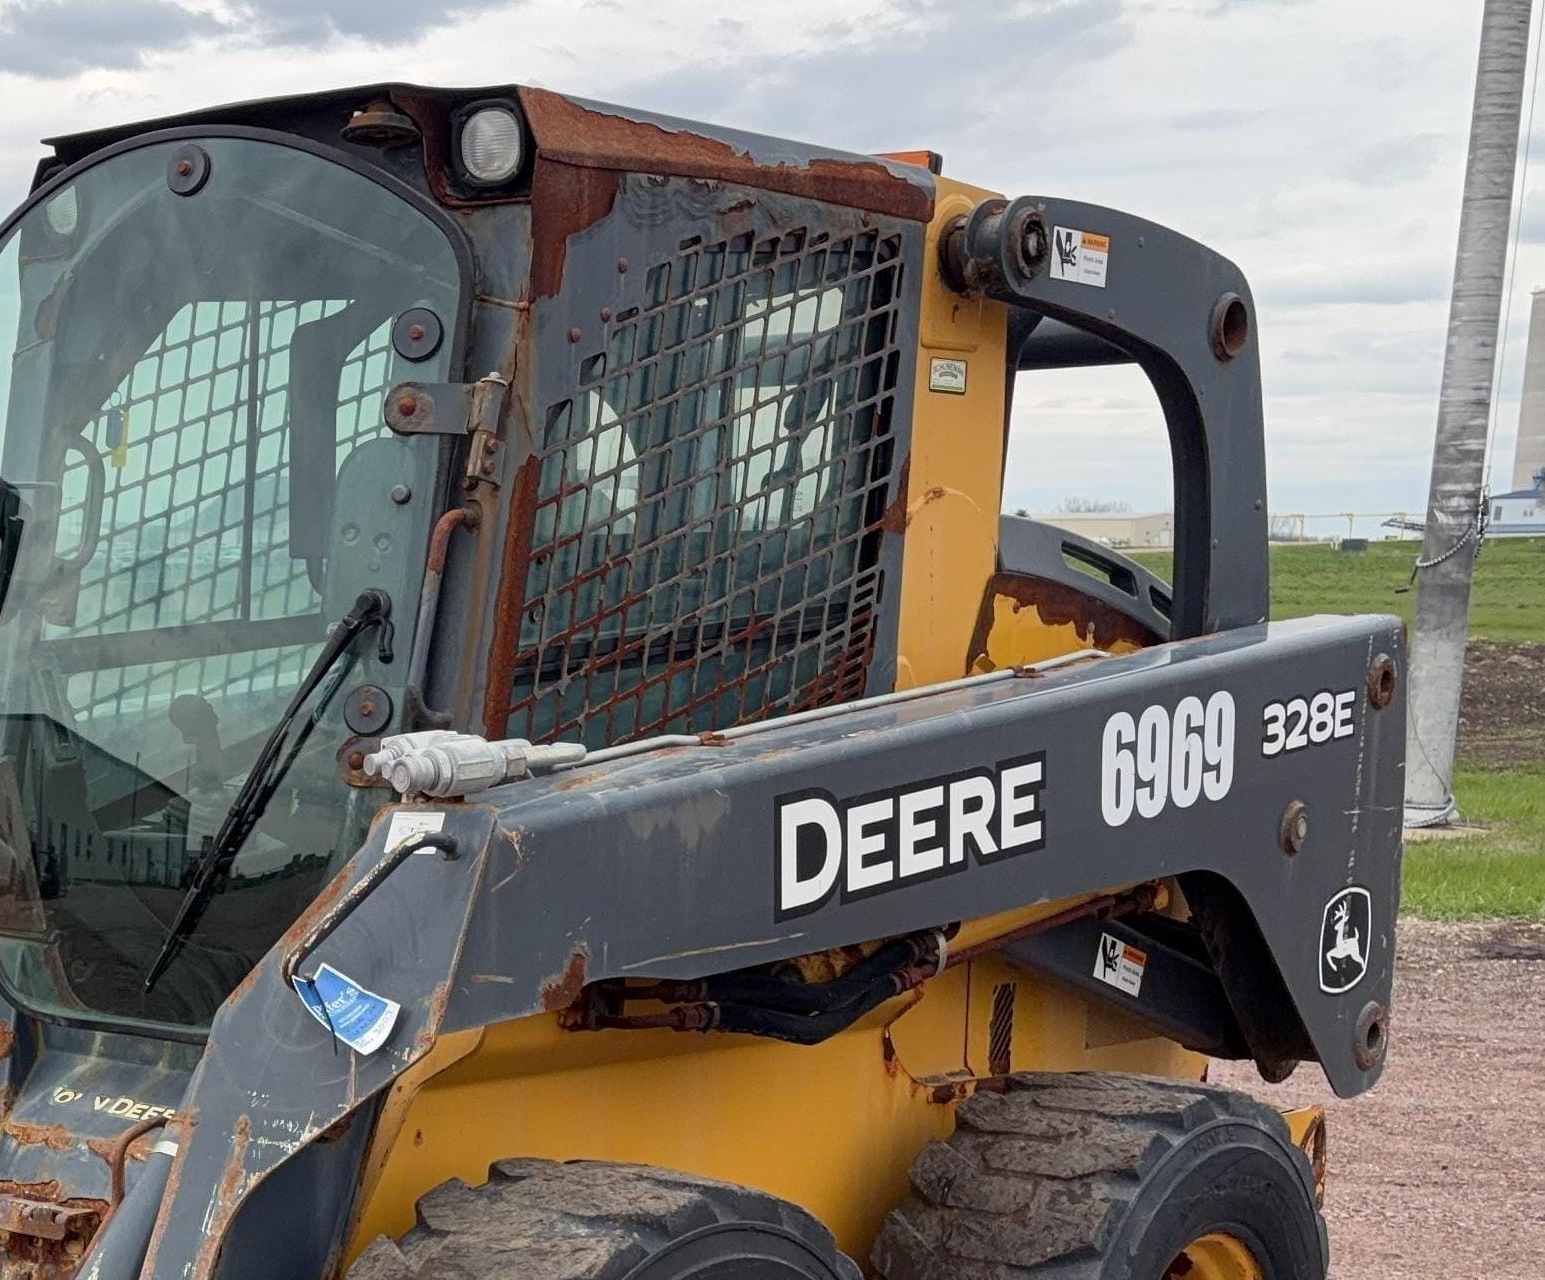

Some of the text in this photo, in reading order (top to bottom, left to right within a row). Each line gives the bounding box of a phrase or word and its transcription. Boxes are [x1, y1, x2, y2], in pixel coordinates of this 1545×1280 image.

[1101, 691, 1235, 827] 6969
[1262, 691, 1355, 756] 328E
[781, 761, 1043, 910] DEERE
